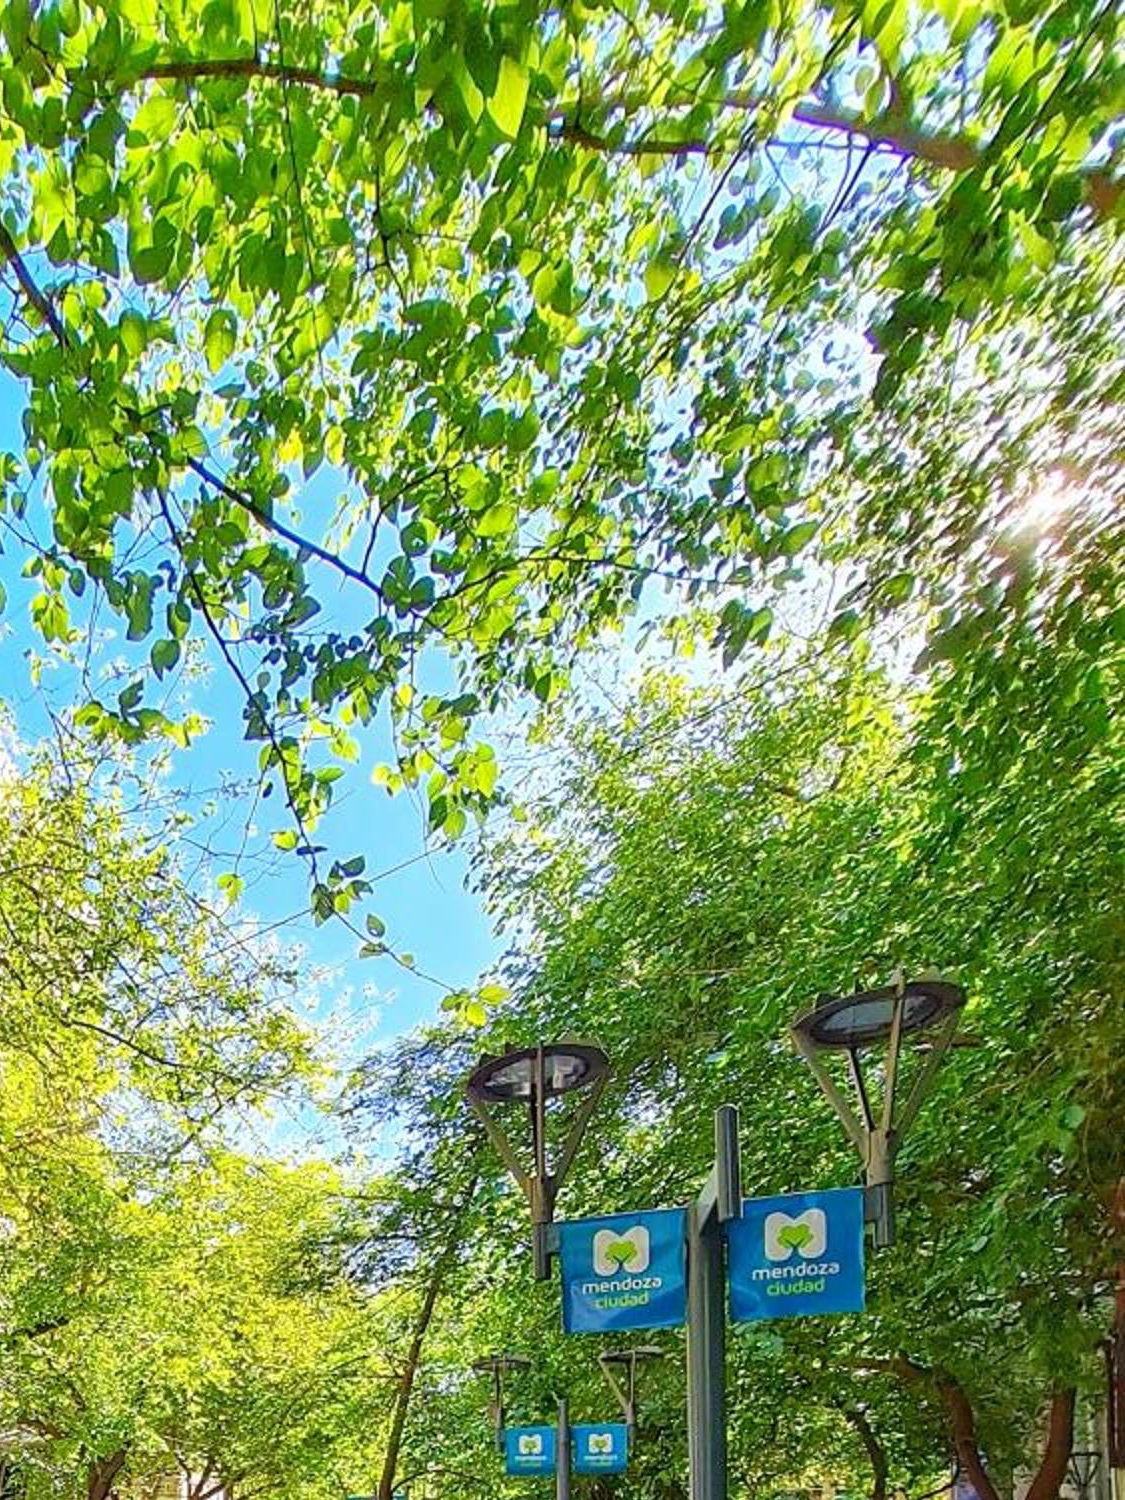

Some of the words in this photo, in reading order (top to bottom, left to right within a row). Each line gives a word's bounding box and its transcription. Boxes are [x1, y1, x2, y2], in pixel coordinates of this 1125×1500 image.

[752, 1261, 840, 1281] mendoza
[582, 1277, 662, 1295] mendoza
[767, 1278, 826, 1297] ciudad
[594, 1292, 651, 1309] ciudad
